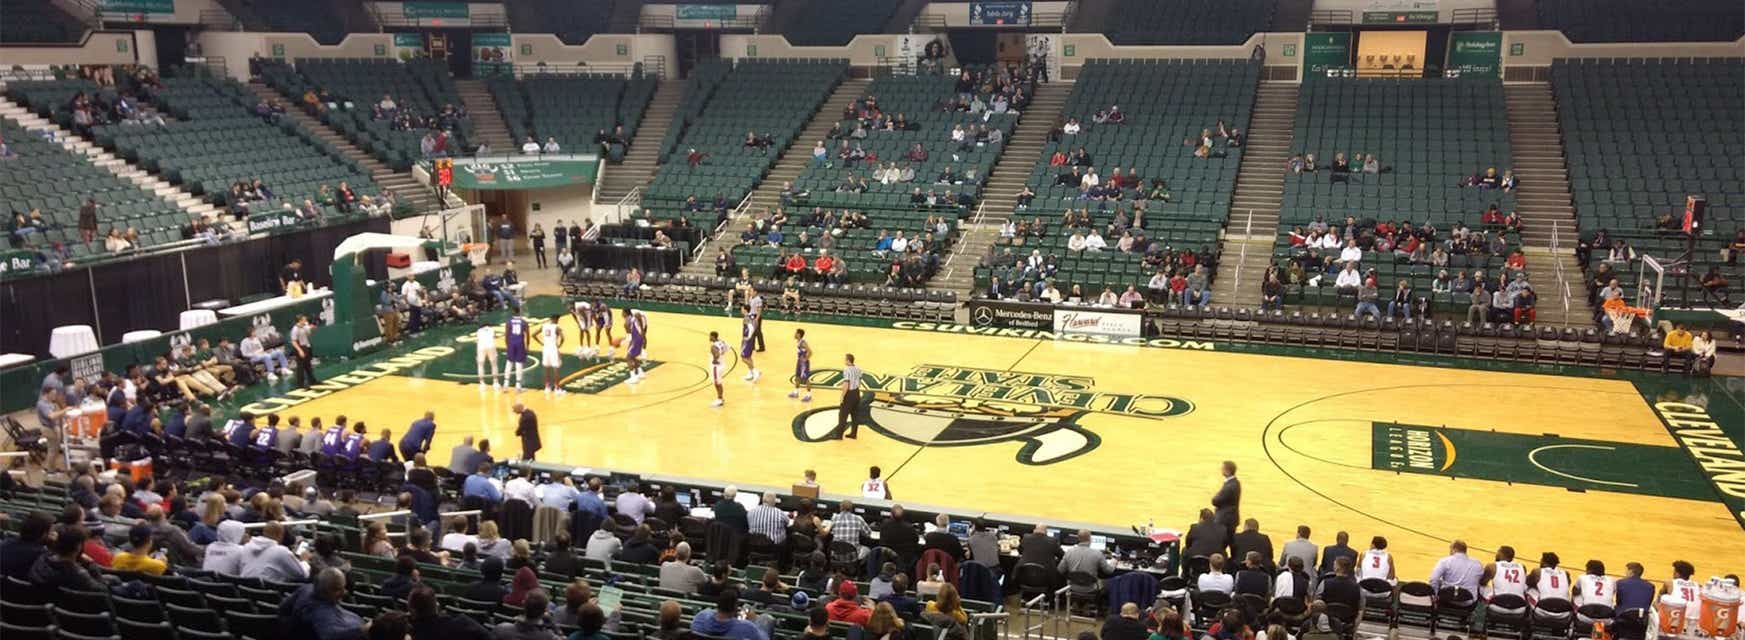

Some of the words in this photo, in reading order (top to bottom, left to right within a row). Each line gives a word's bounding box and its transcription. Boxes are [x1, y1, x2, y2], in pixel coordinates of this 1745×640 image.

[282, 215, 296, 227] Bar
[11, 257, 31, 270] Bar
[995, 308, 1052, 322] Mercedes-Benz
[892, 321, 1215, 350] CSUVIKINGS.COM
[240, 346, 456, 416] CLEVELAND
[911, 364, 1095, 391] STATE
[791, 368, 1196, 418] CLEVELAND
[256, 432, 271, 446] 22
[323, 431, 338, 446] 44
[1389, 427, 1406, 469] LEAGUE
[1406, 429, 1435, 470] HORIZON
[1372, 556, 1381, 569] 3
[1504, 569, 1520, 584] 42
[1551, 576, 1559, 589] 0
[1594, 581, 1604, 596] 2
[1680, 587, 1695, 602] 31
[1670, 608, 1681, 618] G
[1716, 607, 1730, 619] G
